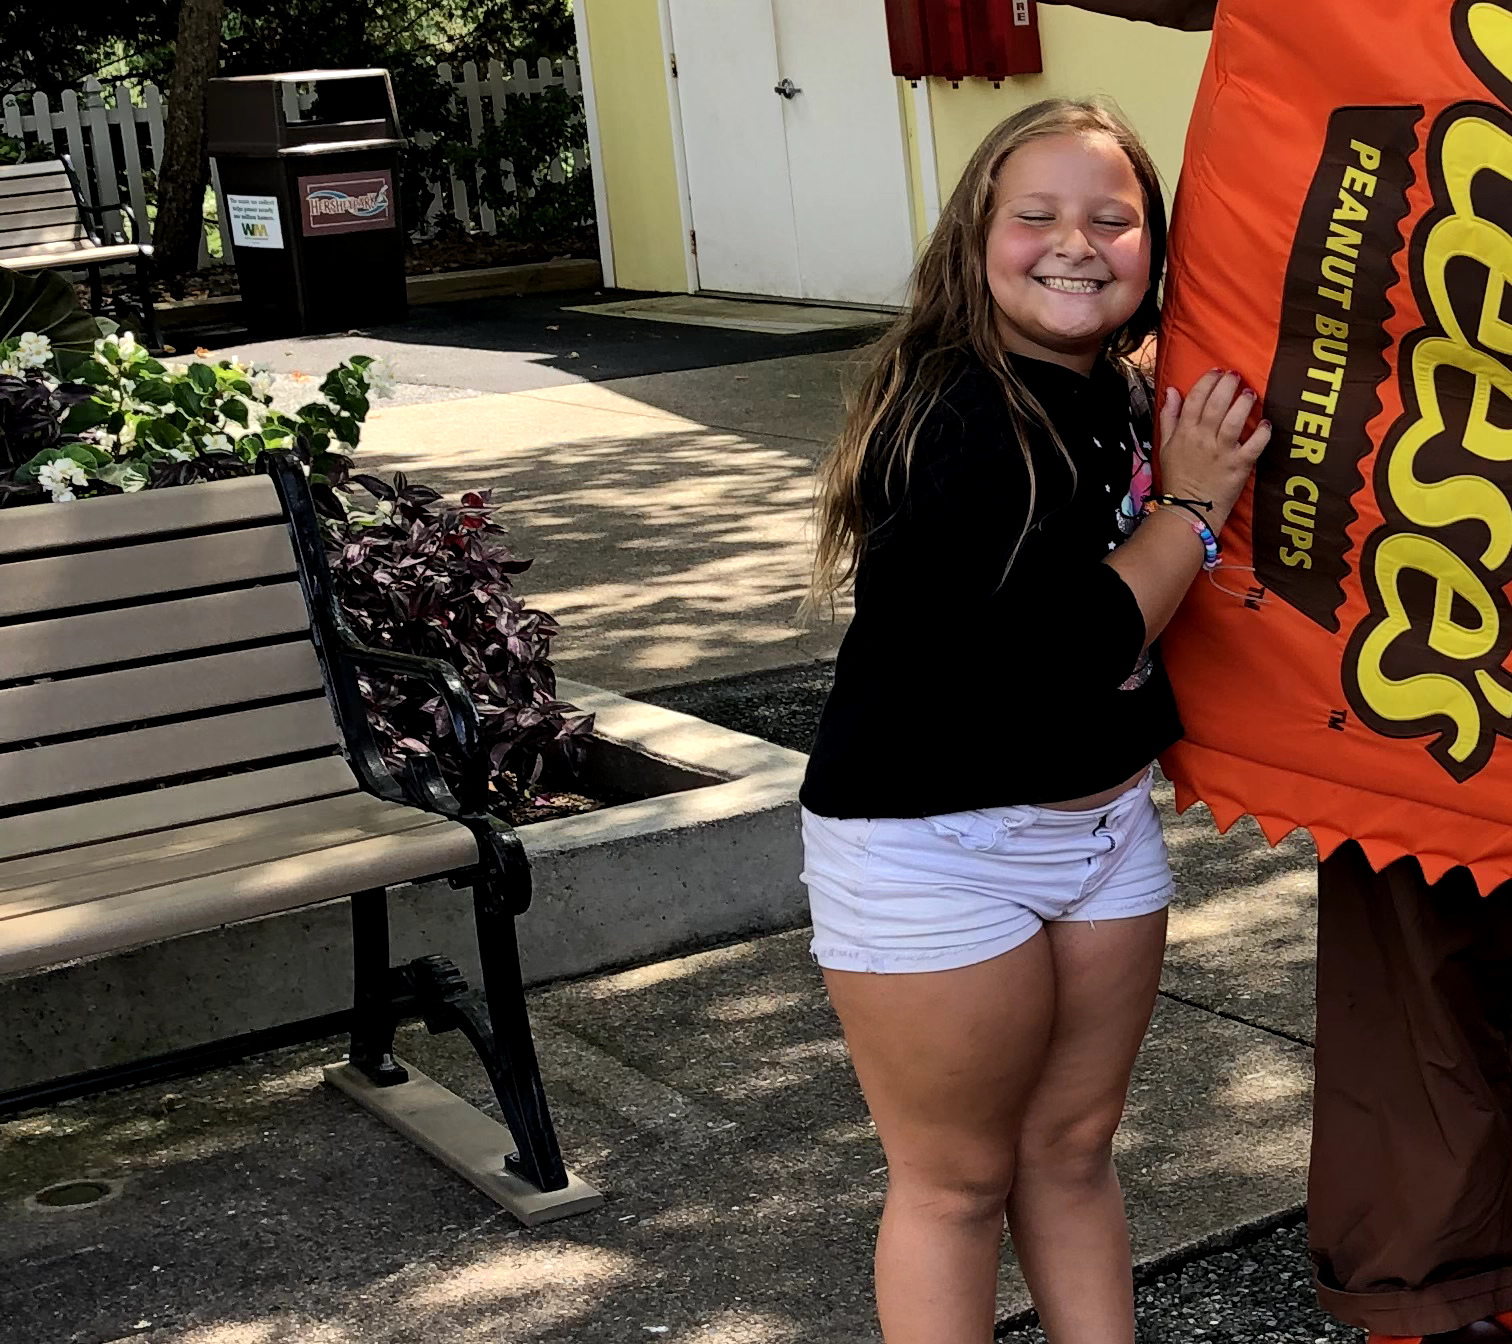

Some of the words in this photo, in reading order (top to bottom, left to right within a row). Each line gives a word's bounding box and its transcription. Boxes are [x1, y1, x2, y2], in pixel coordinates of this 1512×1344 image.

[241, 222, 269, 237] WM
[1317, 139, 1381, 312] PEANUT
[1289, 313, 1349, 465] BUTTER
[1278, 474, 1321, 571] CUPS
